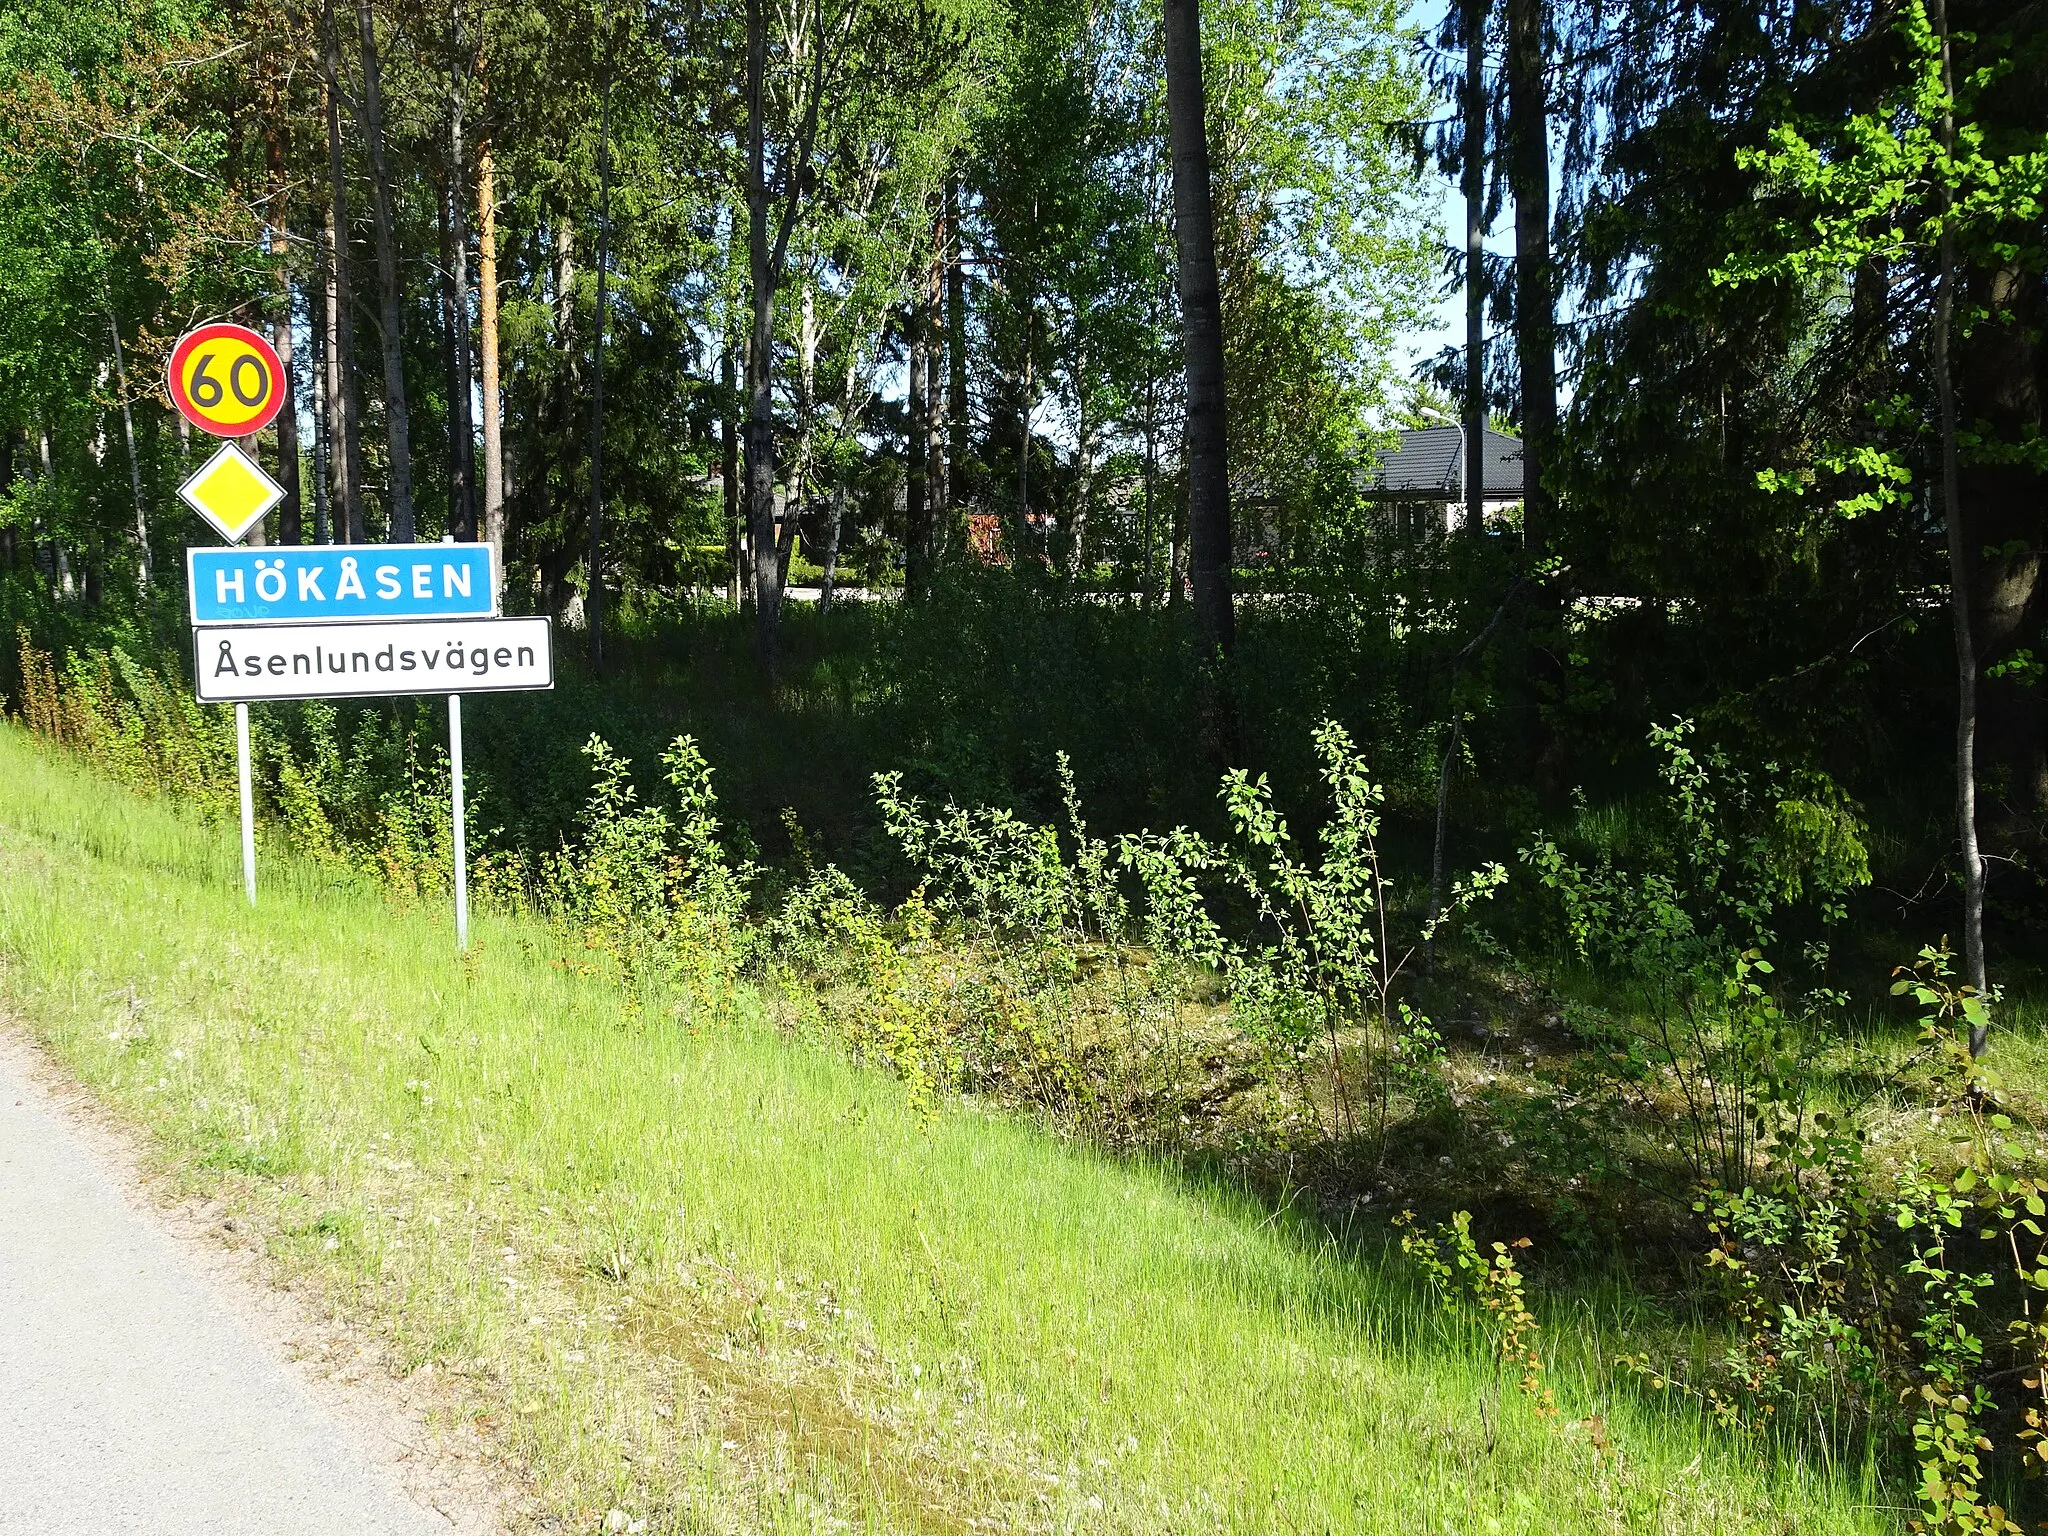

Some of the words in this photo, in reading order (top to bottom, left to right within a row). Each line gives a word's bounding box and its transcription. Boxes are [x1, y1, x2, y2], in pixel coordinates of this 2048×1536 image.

[190, 354, 268, 407] 60
[215, 557, 472, 604] HÖKÅSEN
[213, 640, 535, 677] Åsenlundsvägen
